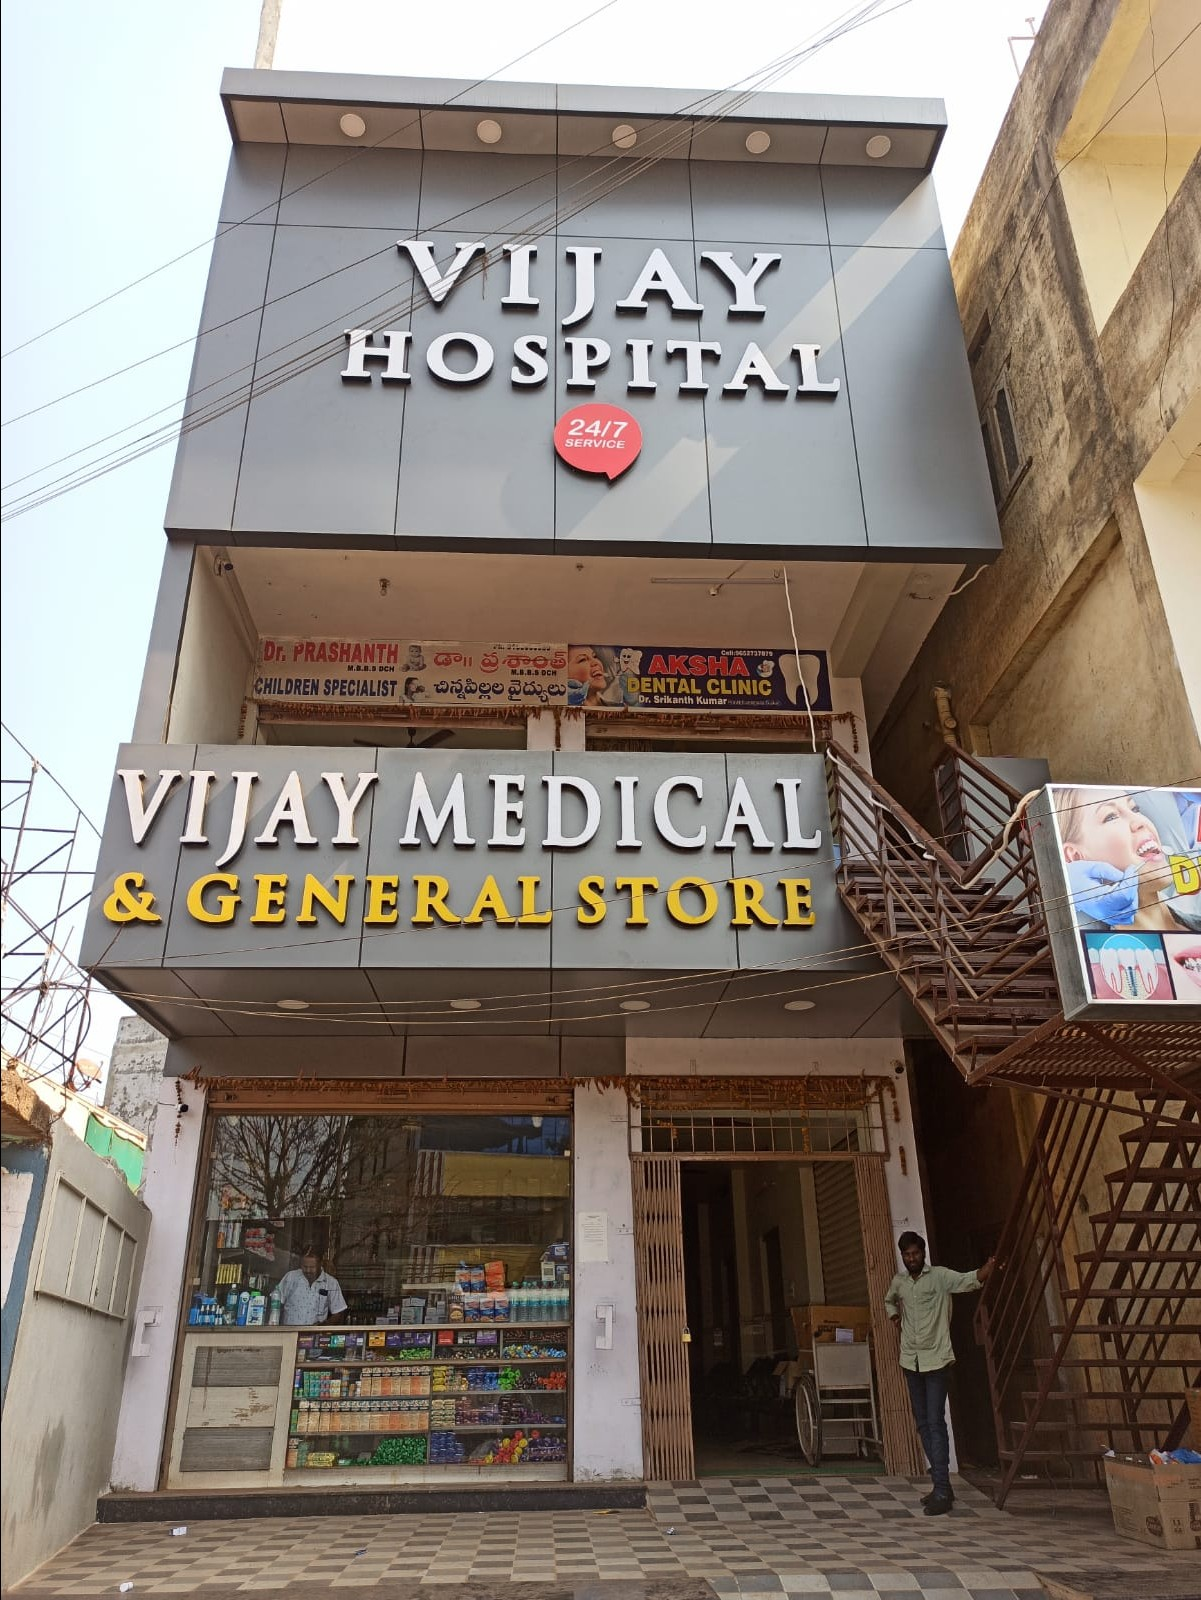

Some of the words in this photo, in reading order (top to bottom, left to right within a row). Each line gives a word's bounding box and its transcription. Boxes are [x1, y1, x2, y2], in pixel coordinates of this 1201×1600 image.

[397, 239, 782, 328] VIJAY
[341, 329, 842, 398] HOSPITAL
[568, 419, 628, 438] 24/7
[565, 439, 626, 449] SERVICE
[263, 641, 286, 662] Dr.
[293, 642, 399, 664] PRASHANTH
[648, 654, 750, 676] AKSHA
[255, 677, 319, 696] CHILDREN
[323, 679, 397, 697] SPECIALIST
[433, 677, 505, 700] చిన్నపిల్లల
[508, 679, 567, 702] వైద్యులు
[627, 677, 702, 695] DENTAL
[707, 679, 773, 696] CLINIC
[638, 695, 651, 704] Dr.
[653, 695, 694, 705] Srikanth
[696, 696, 728, 705] Kumar
[118, 768, 379, 868] VIJAY
[400, 771, 822, 850] MEDICAL
[1168, 854, 1201, 895] D
[103, 872, 161, 924] &
[187, 873, 552, 927] GENERAL
[576, 875, 816, 928] STORE
